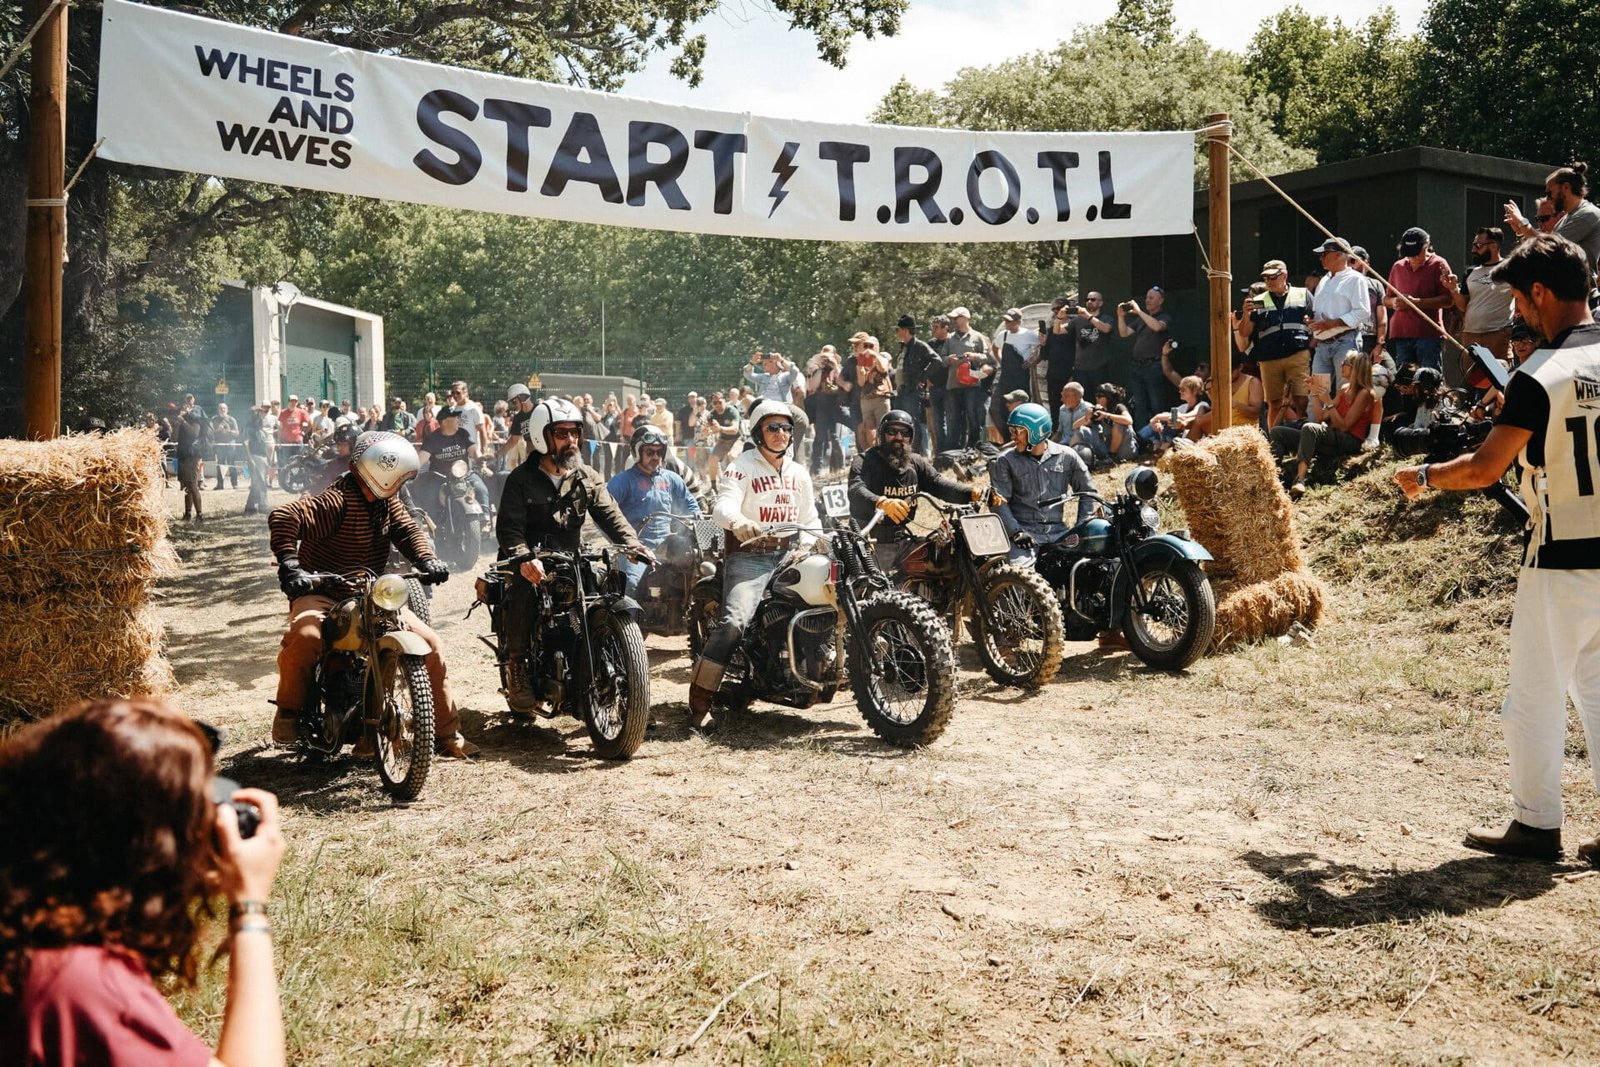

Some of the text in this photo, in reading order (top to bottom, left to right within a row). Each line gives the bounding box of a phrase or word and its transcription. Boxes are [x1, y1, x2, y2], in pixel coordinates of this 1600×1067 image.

[194, 44, 355, 103] WHEELS
[267, 96, 354, 135] AND
[215, 120, 353, 170] WAVES
[412, 89, 1132, 226] START T.R.O.T.L
[1565, 415, 1600, 497] 1
[774, 494, 791, 505] AND
[823, 488, 847, 509] 13
[883, 484, 918, 496] HARLEY
[759, 506, 799, 523] WAVES
